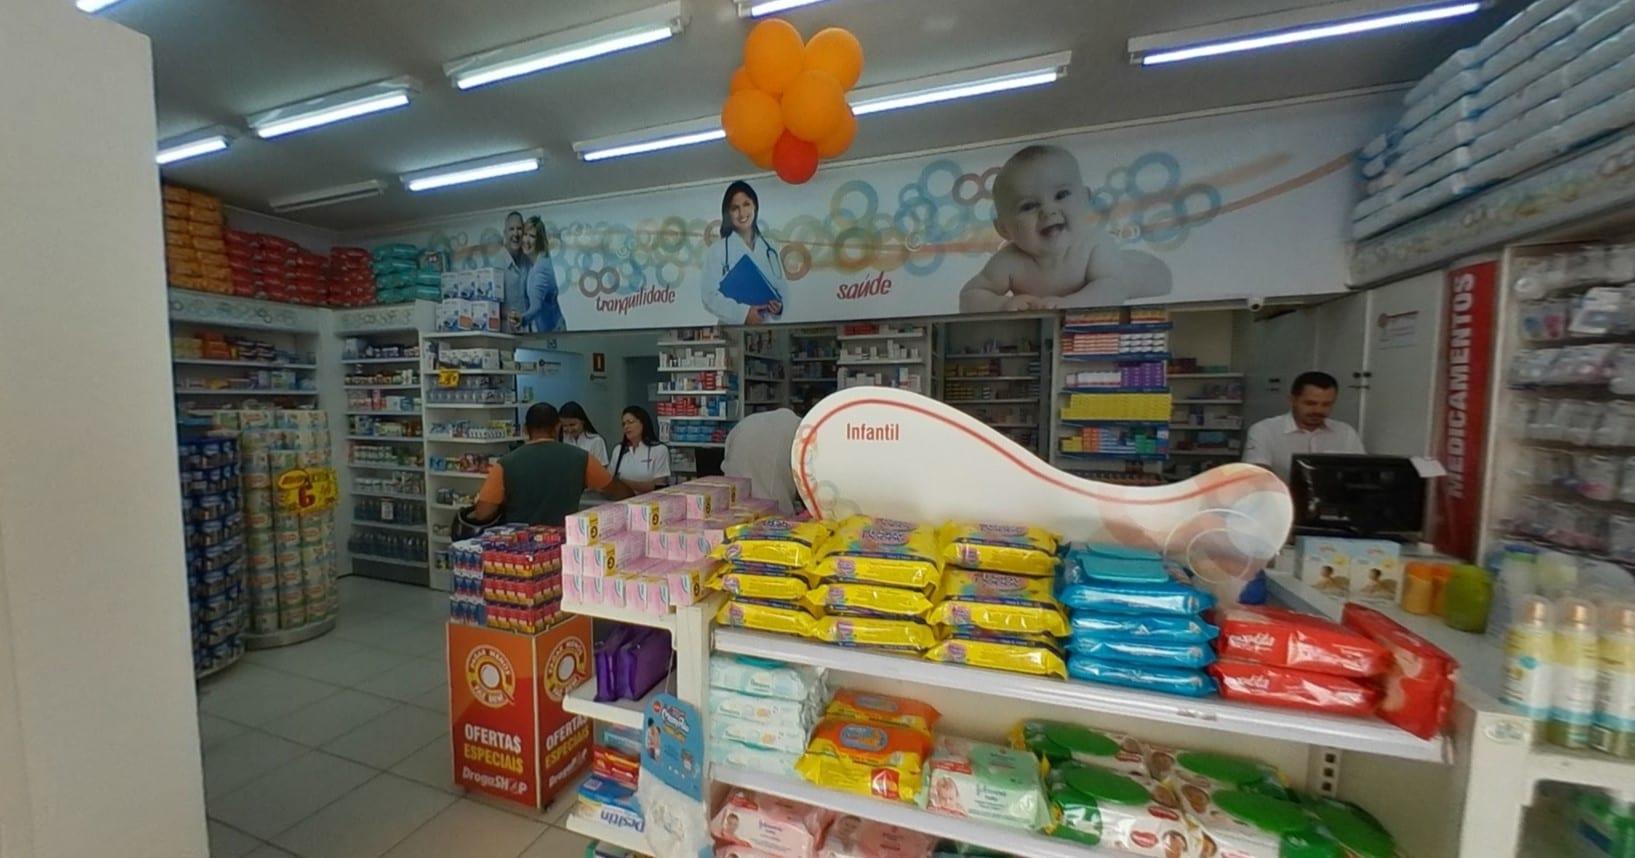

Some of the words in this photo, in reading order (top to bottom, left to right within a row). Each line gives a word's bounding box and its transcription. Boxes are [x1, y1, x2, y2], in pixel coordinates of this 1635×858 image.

[595, 283, 676, 316] tranquilidade
[837, 270, 892, 300] saúde
[1448, 272, 1477, 499] MEDICAMENTOS
[846, 422, 900, 441] Infantil
[464, 723, 522, 754] OFERTAS
[464, 743, 524, 775] ESPECIAIS
[600, 810, 645, 832] Desitin
